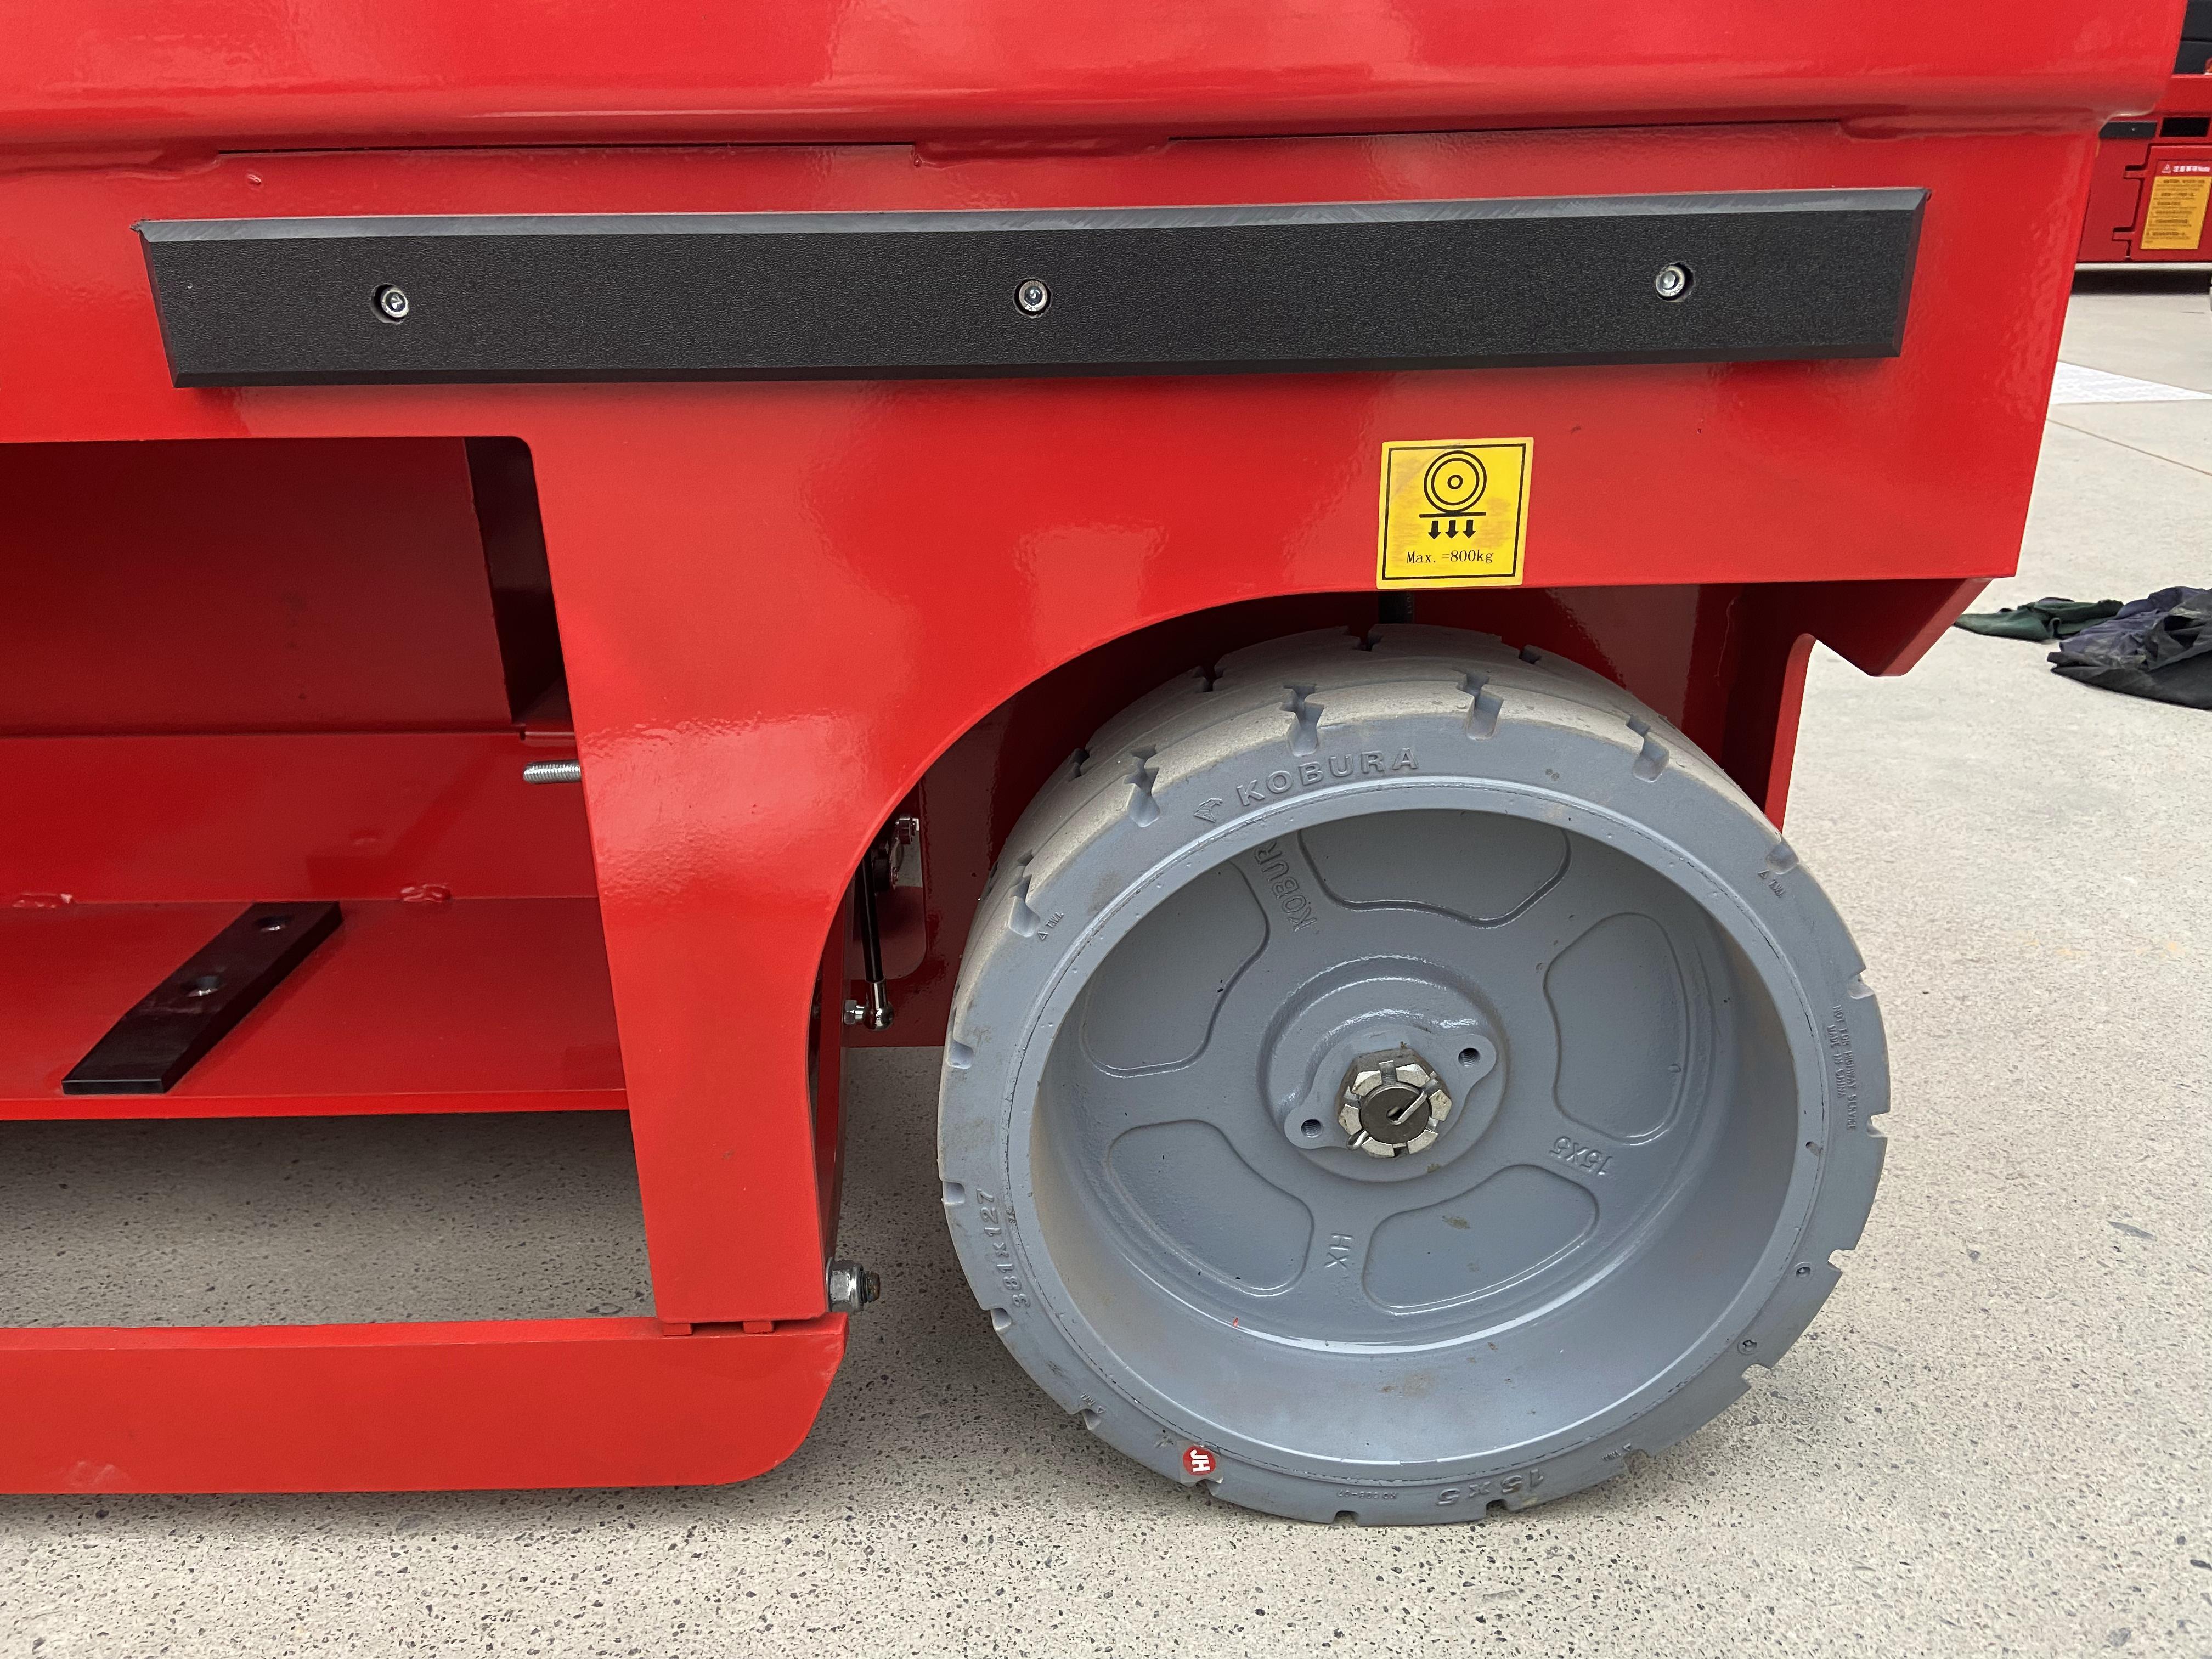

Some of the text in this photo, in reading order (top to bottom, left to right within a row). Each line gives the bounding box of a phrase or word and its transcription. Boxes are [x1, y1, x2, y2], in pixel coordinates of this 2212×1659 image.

[1407, 549, 1494, 564] Max. =800kg
[1237, 747, 1419, 806] KOBURA
[1190, 1449, 1211, 1473] JH
